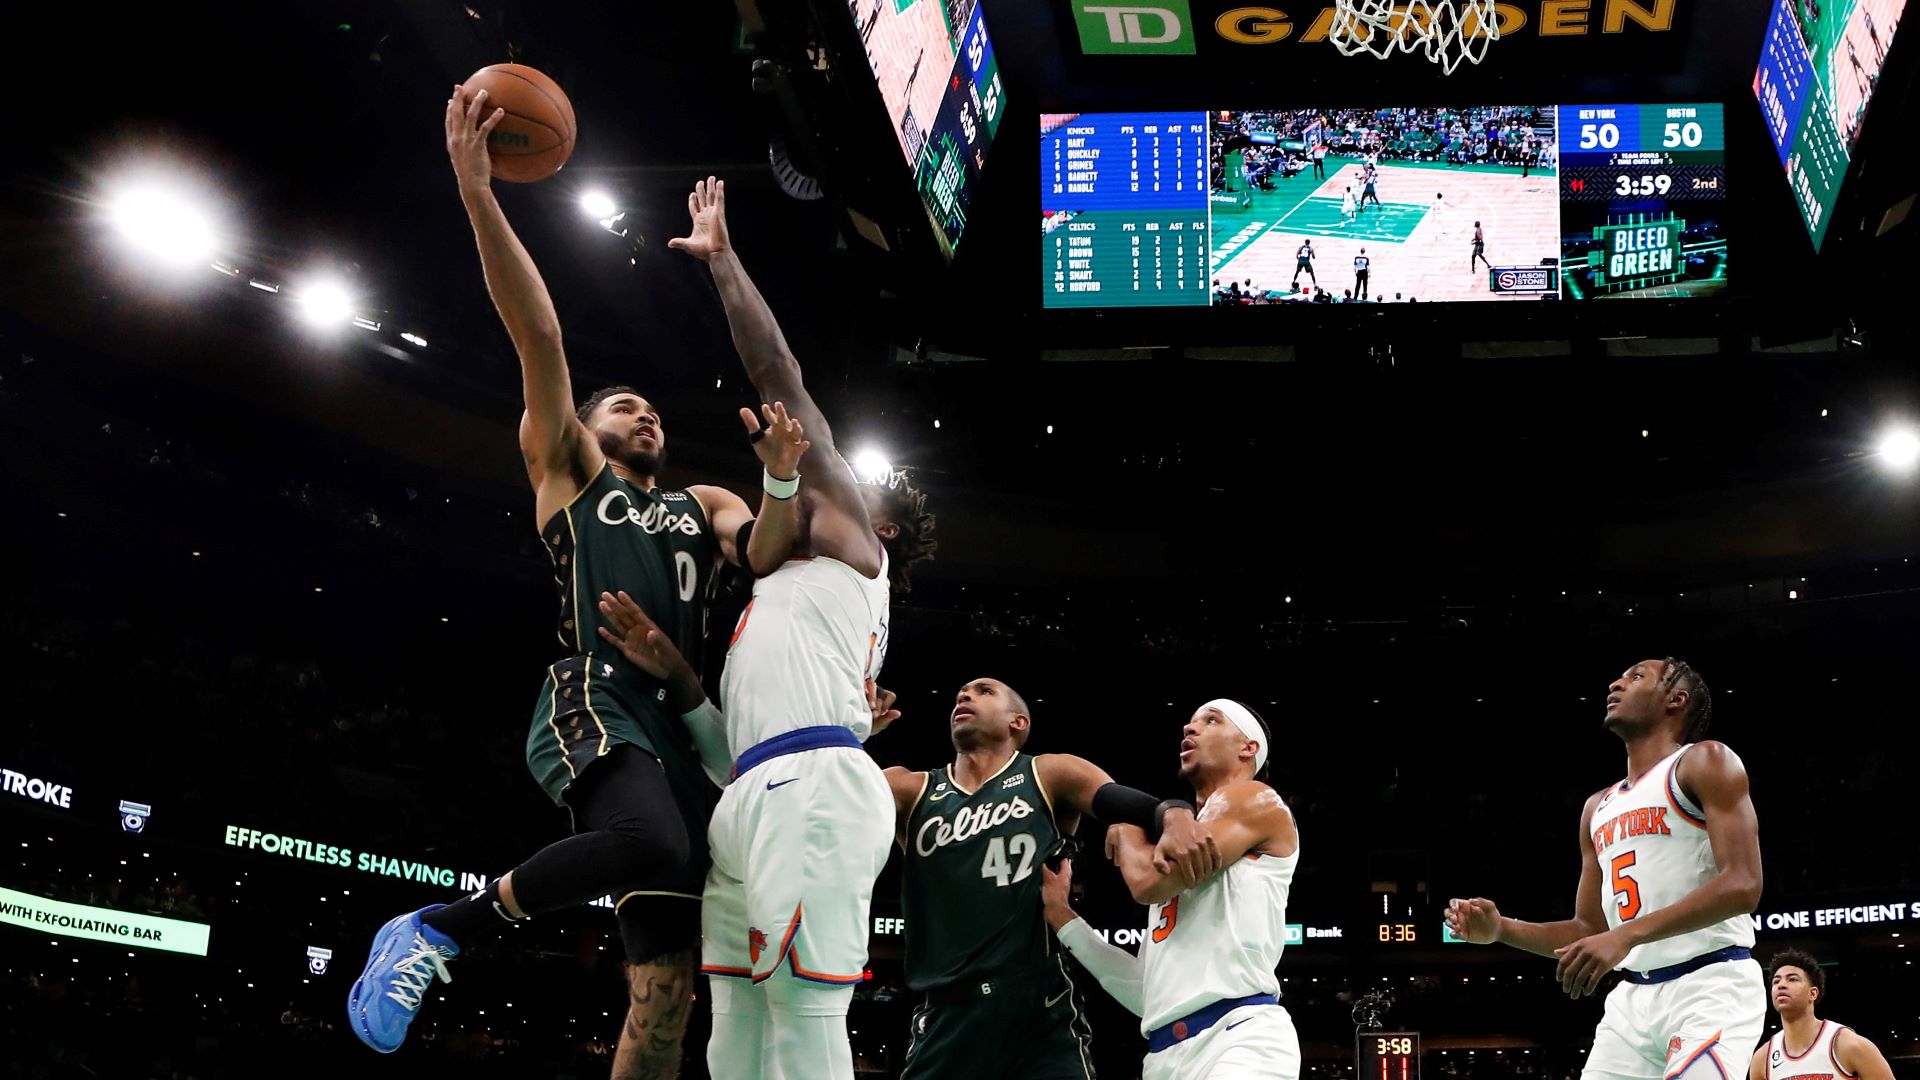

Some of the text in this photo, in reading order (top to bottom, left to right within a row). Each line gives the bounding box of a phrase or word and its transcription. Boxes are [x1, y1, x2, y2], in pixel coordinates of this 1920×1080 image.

[1083, 0, 1676, 44] TD GARDEN
[1579, 109, 1616, 119] NEW YORK
[1666, 108, 1696, 118] BOSTON
[1067, 127, 1095, 135] KNICKS
[1121, 126, 1134, 134] PTS
[1168, 125, 1181, 133] AST
[1191, 125, 1203, 133] FLS
[1580, 123, 1620, 149] 50
[1663, 122, 1703, 148] 50
[1615, 174, 1672, 196] 3:59
[1692, 177, 1718, 189] 2nd
[1069, 223, 1096, 231] CELTICS
[1146, 223, 1159, 231] REB
[1193, 222, 1205, 230] FLS
[1069, 237, 1091, 246] TATUM
[1615, 227, 1668, 253] BLEED
[1610, 248, 1673, 277] GREEN
[674, 551, 698, 602] 0
[0, 768, 73, 808] TROKE
[1003, 773, 1025, 785] VISTA
[916, 796, 1034, 857] Celtics
[1619, 807, 1672, 841] YORK
[225, 825, 486, 892] EFFORTLESS SHAVING IN
[981, 833, 1037, 888] 42
[1612, 850, 1641, 922] 5
[0, 902, 162, 941] WITH EXFOLIATING BAR
[1152, 895, 1179, 944] 3
[1766, 911, 1810, 930] ONE
[1815, 903, 1907, 926] EFFICIENT
[1306, 926, 1343, 938] Bank
[1379, 924, 1416, 942] 8:36
[981, 982, 992, 995] 6
[1377, 1038, 1412, 1055] 3:58
